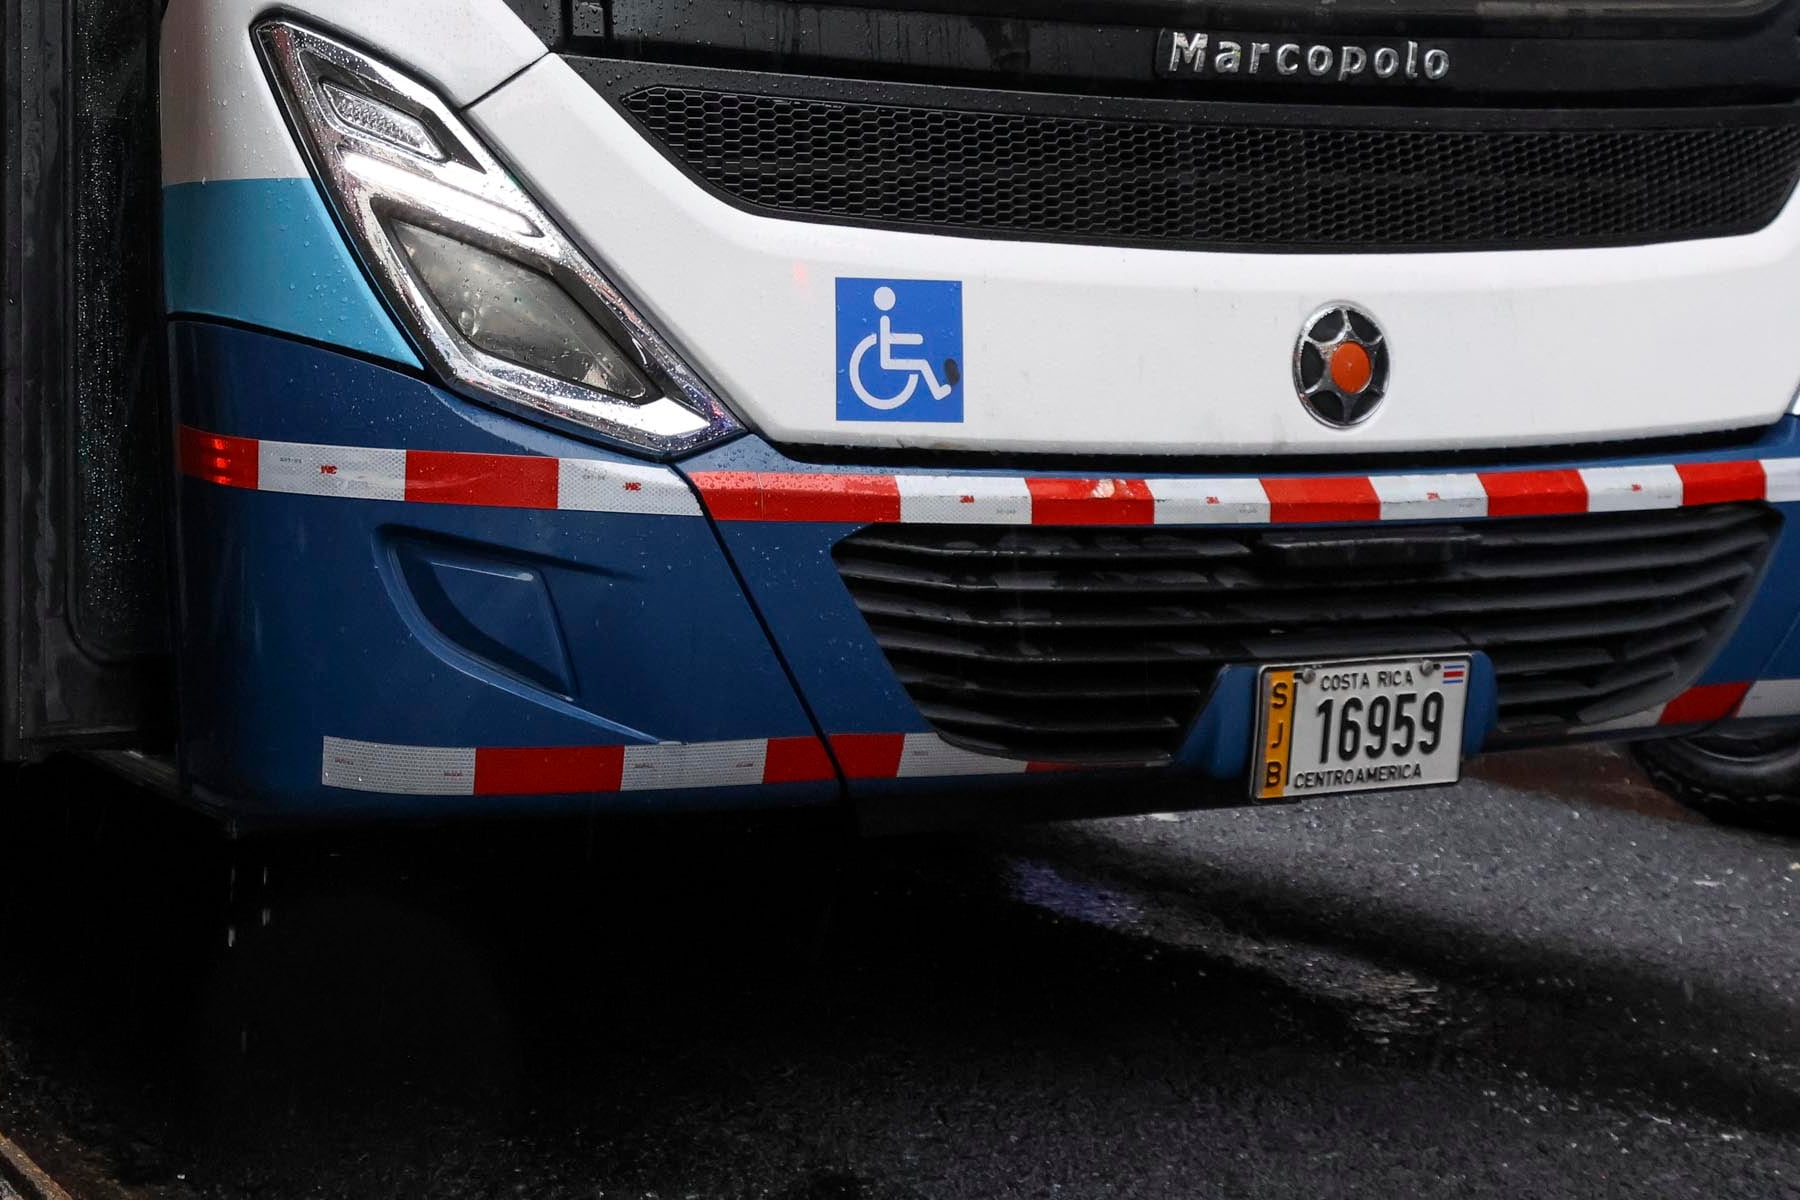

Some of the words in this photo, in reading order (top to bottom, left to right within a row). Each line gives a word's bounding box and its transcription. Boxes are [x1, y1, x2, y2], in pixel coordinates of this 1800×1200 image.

[1169, 31, 1450, 82] Marcopolo
[1320, 672, 1370, 691] COSTA
[1378, 670, 1414, 687] RICA
[1317, 691, 1445, 764] 16959
[1294, 763, 1422, 789] CENTROAMERICA
